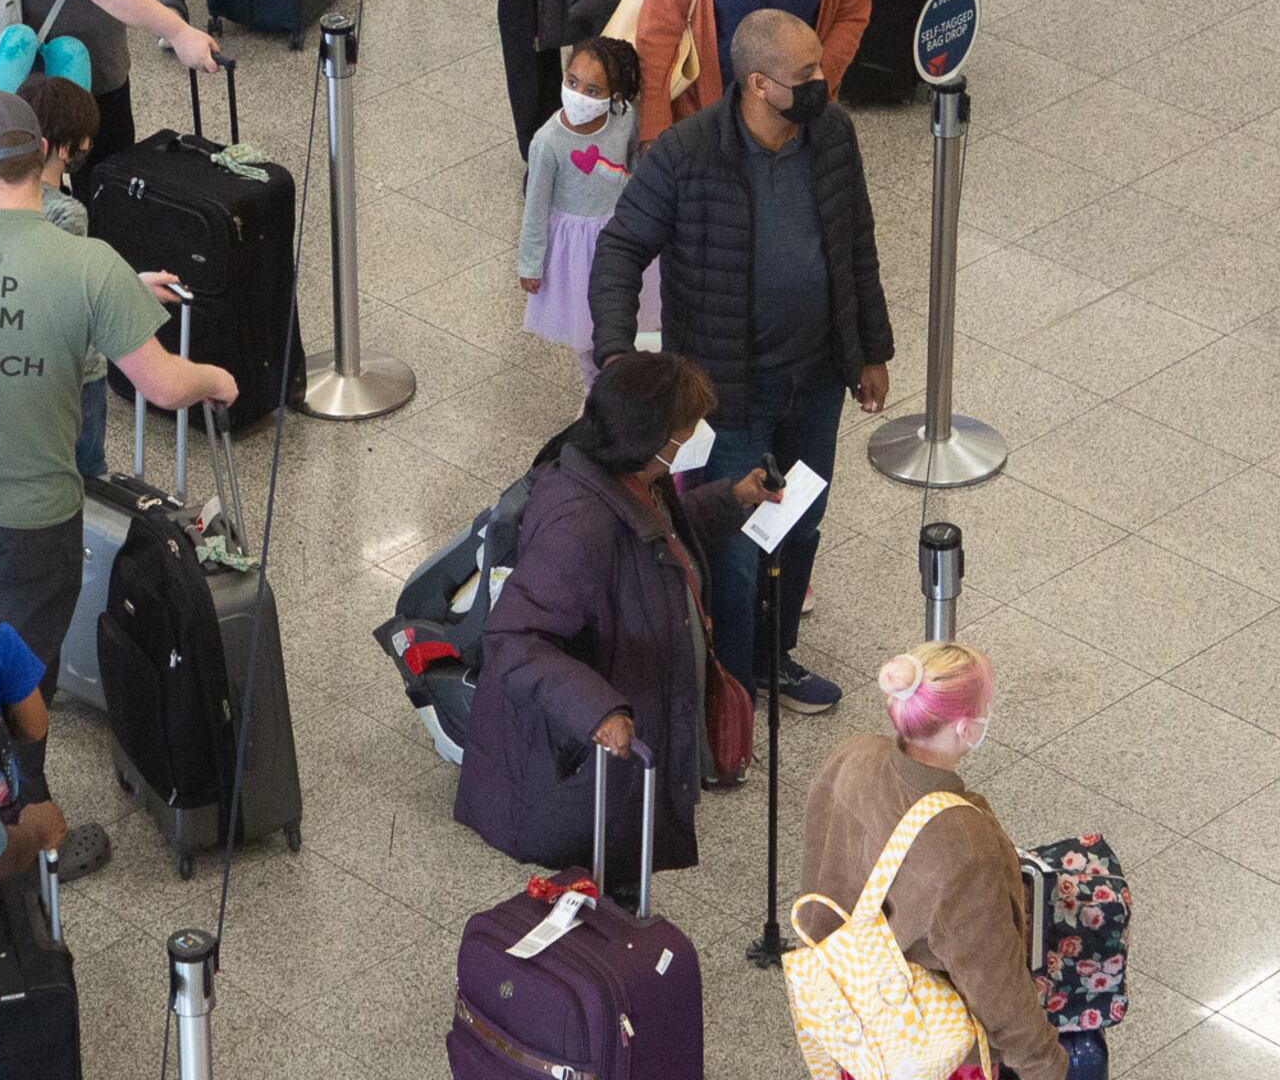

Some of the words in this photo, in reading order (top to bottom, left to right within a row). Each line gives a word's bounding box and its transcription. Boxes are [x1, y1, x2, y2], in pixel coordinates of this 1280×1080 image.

[921, 9, 974, 44] SELF-TAGGED
[926, 36, 944, 52] BAG
[945, 24, 968, 43] DROP
